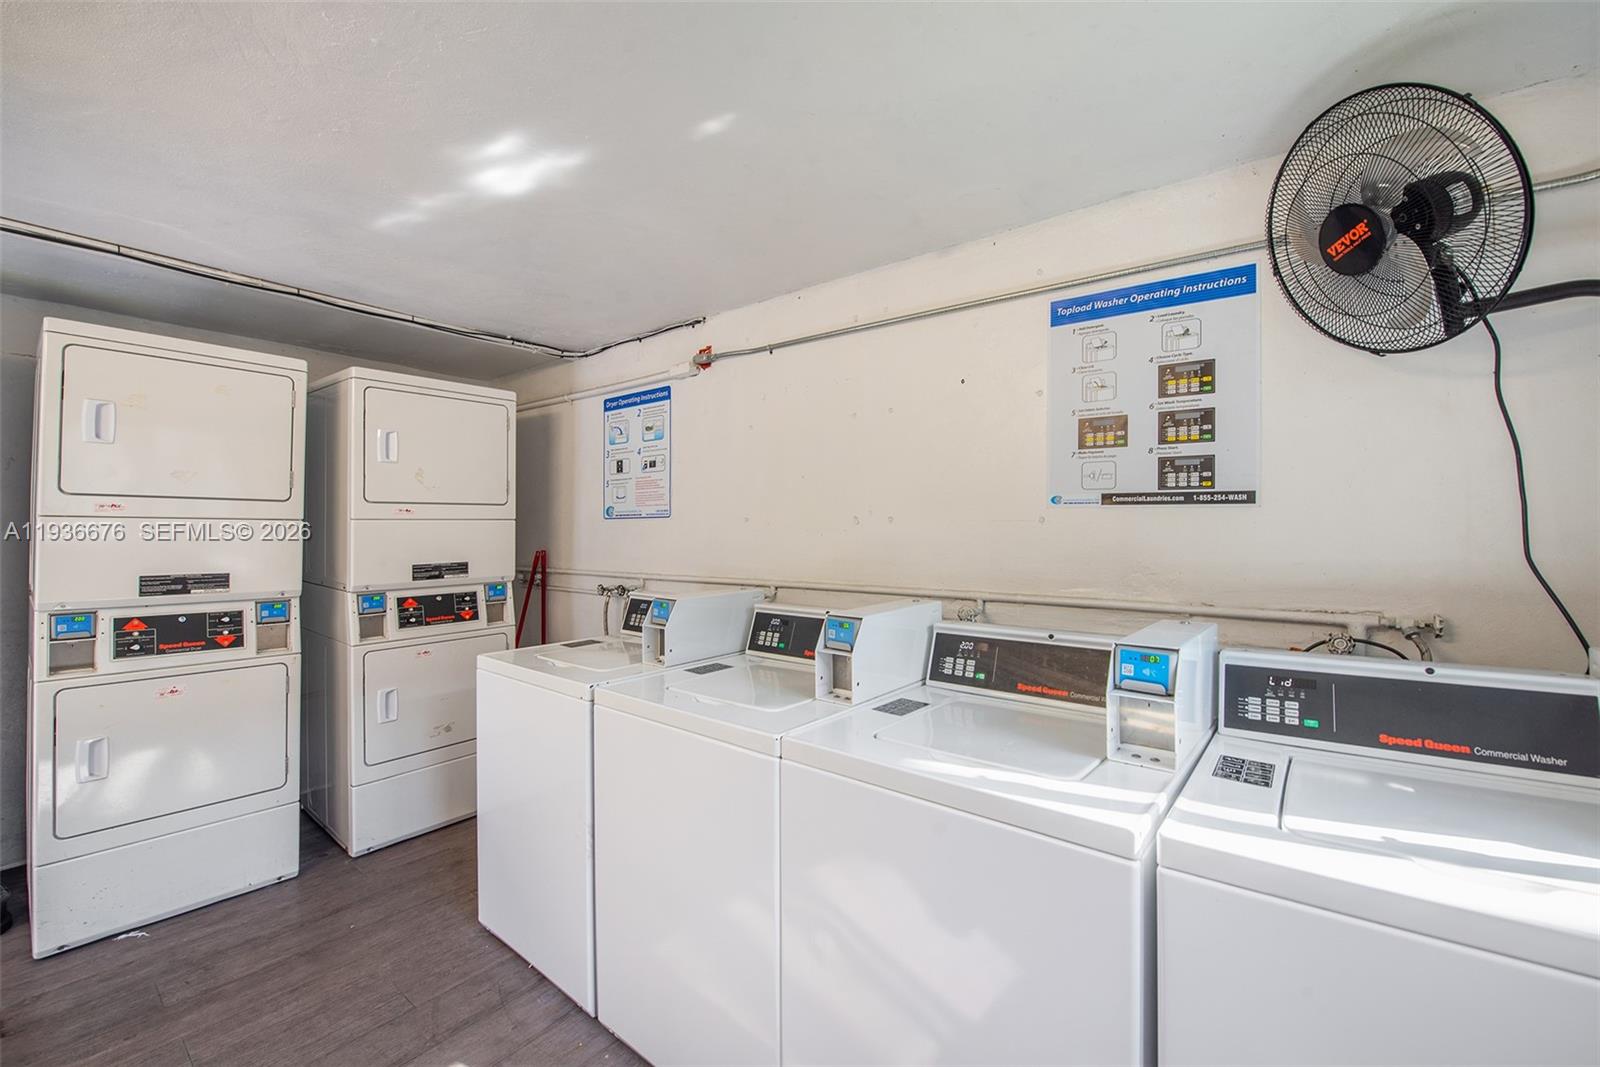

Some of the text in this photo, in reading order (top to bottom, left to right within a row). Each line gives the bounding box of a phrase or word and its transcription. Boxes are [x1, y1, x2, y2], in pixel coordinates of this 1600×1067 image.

[1326, 222, 1369, 256] VEVOR
[1057, 275, 1247, 316] Topload Washer Operating Instructions
[606, 390, 669, 409] Dryer Operating Instructions
[1112, 493, 1248, 503] CommercialLaundries.com 1-855-254-WASH
[159, 640, 206, 650] Speed Queen
[803, 649, 816, 657] Spe
[1016, 682, 1042, 693] Speed
[1042, 685, 1070, 697] Queen
[1070, 691, 1100, 702] Commercial
[1378, 733, 1568, 767] Speed Queen Commercial Washer
